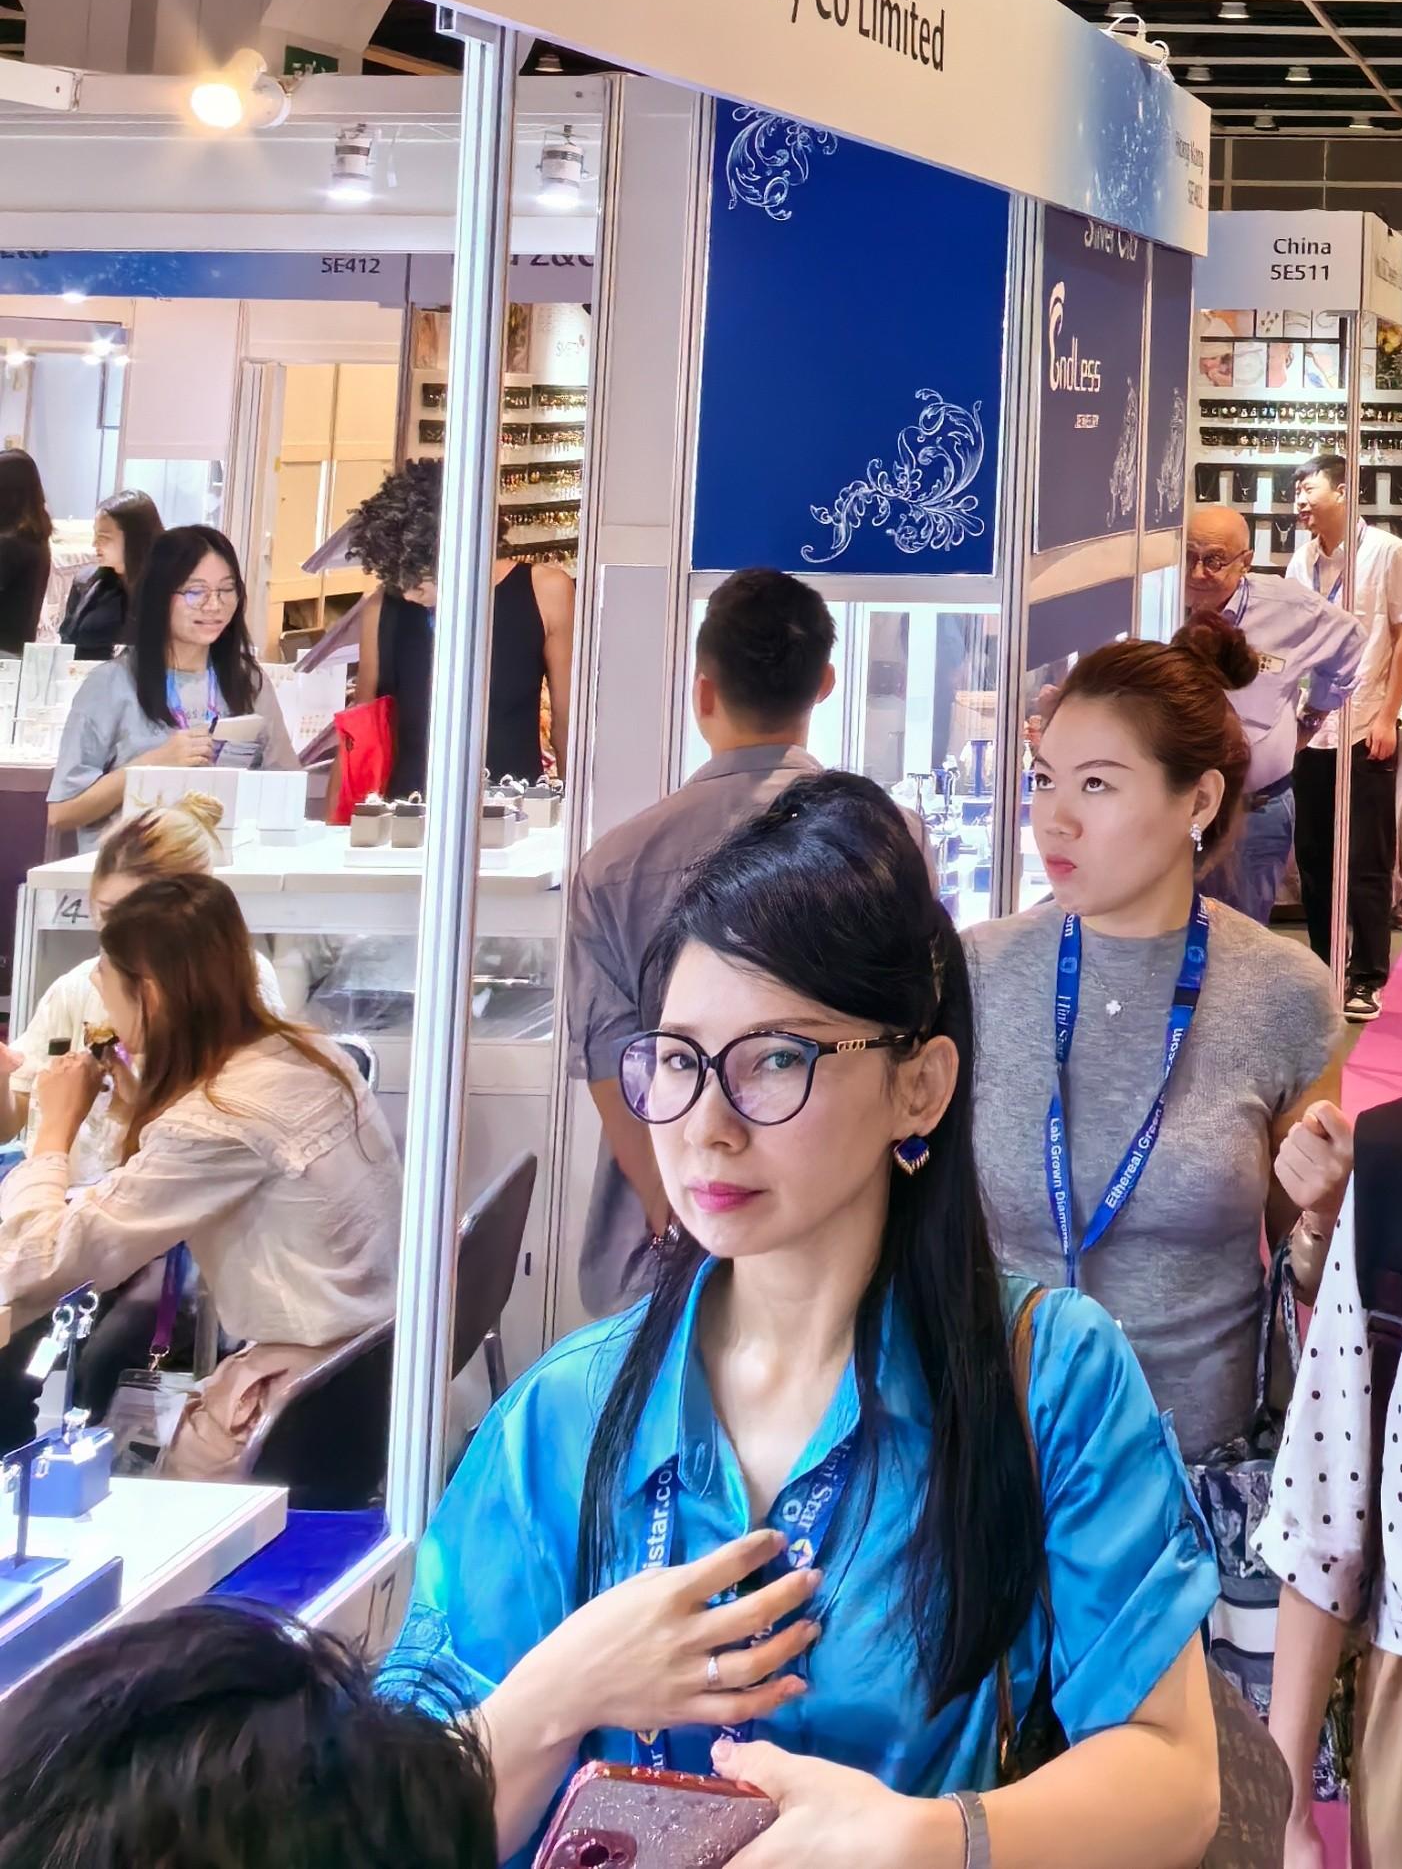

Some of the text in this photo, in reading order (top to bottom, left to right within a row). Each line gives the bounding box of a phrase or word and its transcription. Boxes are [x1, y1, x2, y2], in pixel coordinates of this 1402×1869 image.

[1273, 237, 1332, 255] China
[1270, 264, 1329, 281] 5E511
[1050, 1117, 1061, 1142] Lab
[1104, 1150, 1144, 1209] Ethereal
